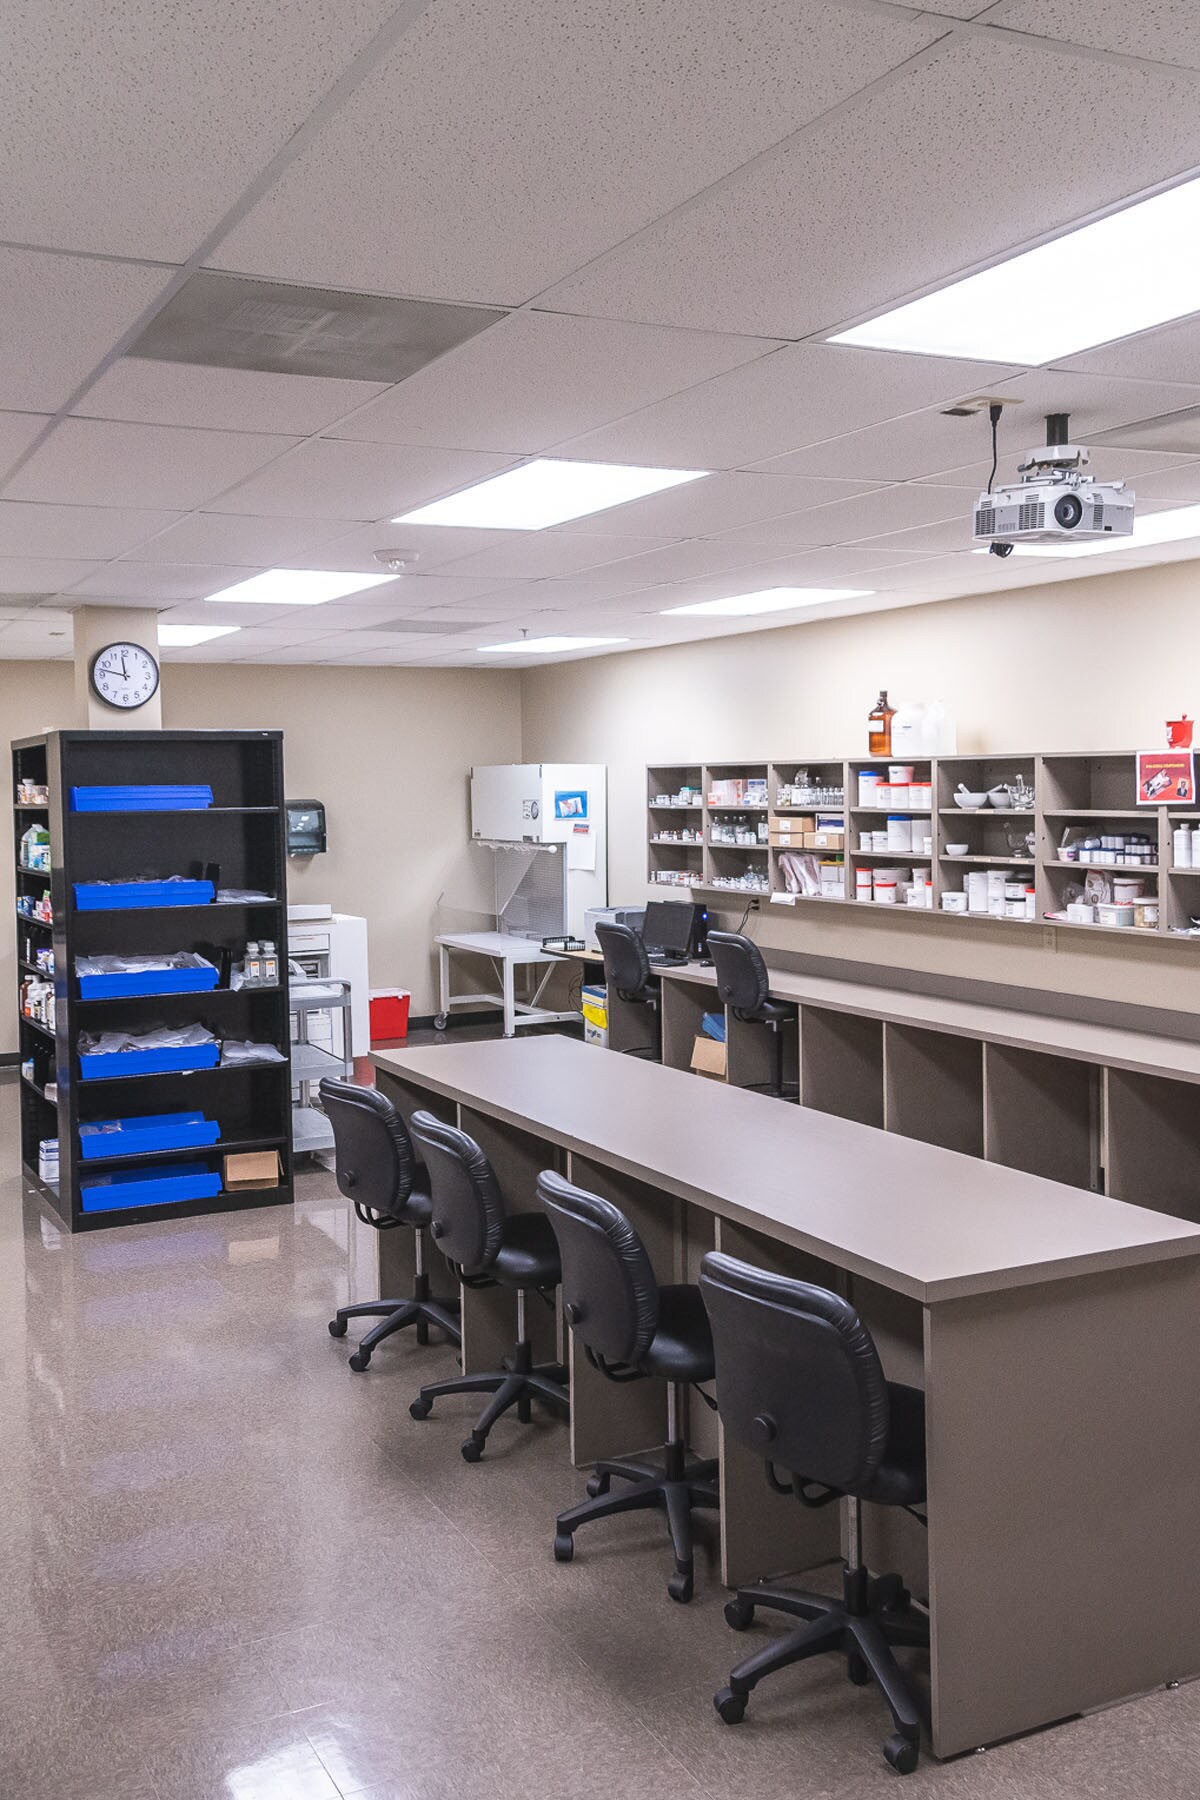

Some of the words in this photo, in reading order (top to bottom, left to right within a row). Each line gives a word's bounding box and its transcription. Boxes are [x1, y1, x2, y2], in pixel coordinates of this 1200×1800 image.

[121, 649, 129, 658] 12
[134, 652, 138, 660] 1
[102, 660, 111, 668] 10
[142, 660, 148, 668] 2
[99, 671, 106, 679] 9
[145, 672, 151, 680] 3
[102, 682, 109, 691] 8
[134, 691, 140, 699] 5
